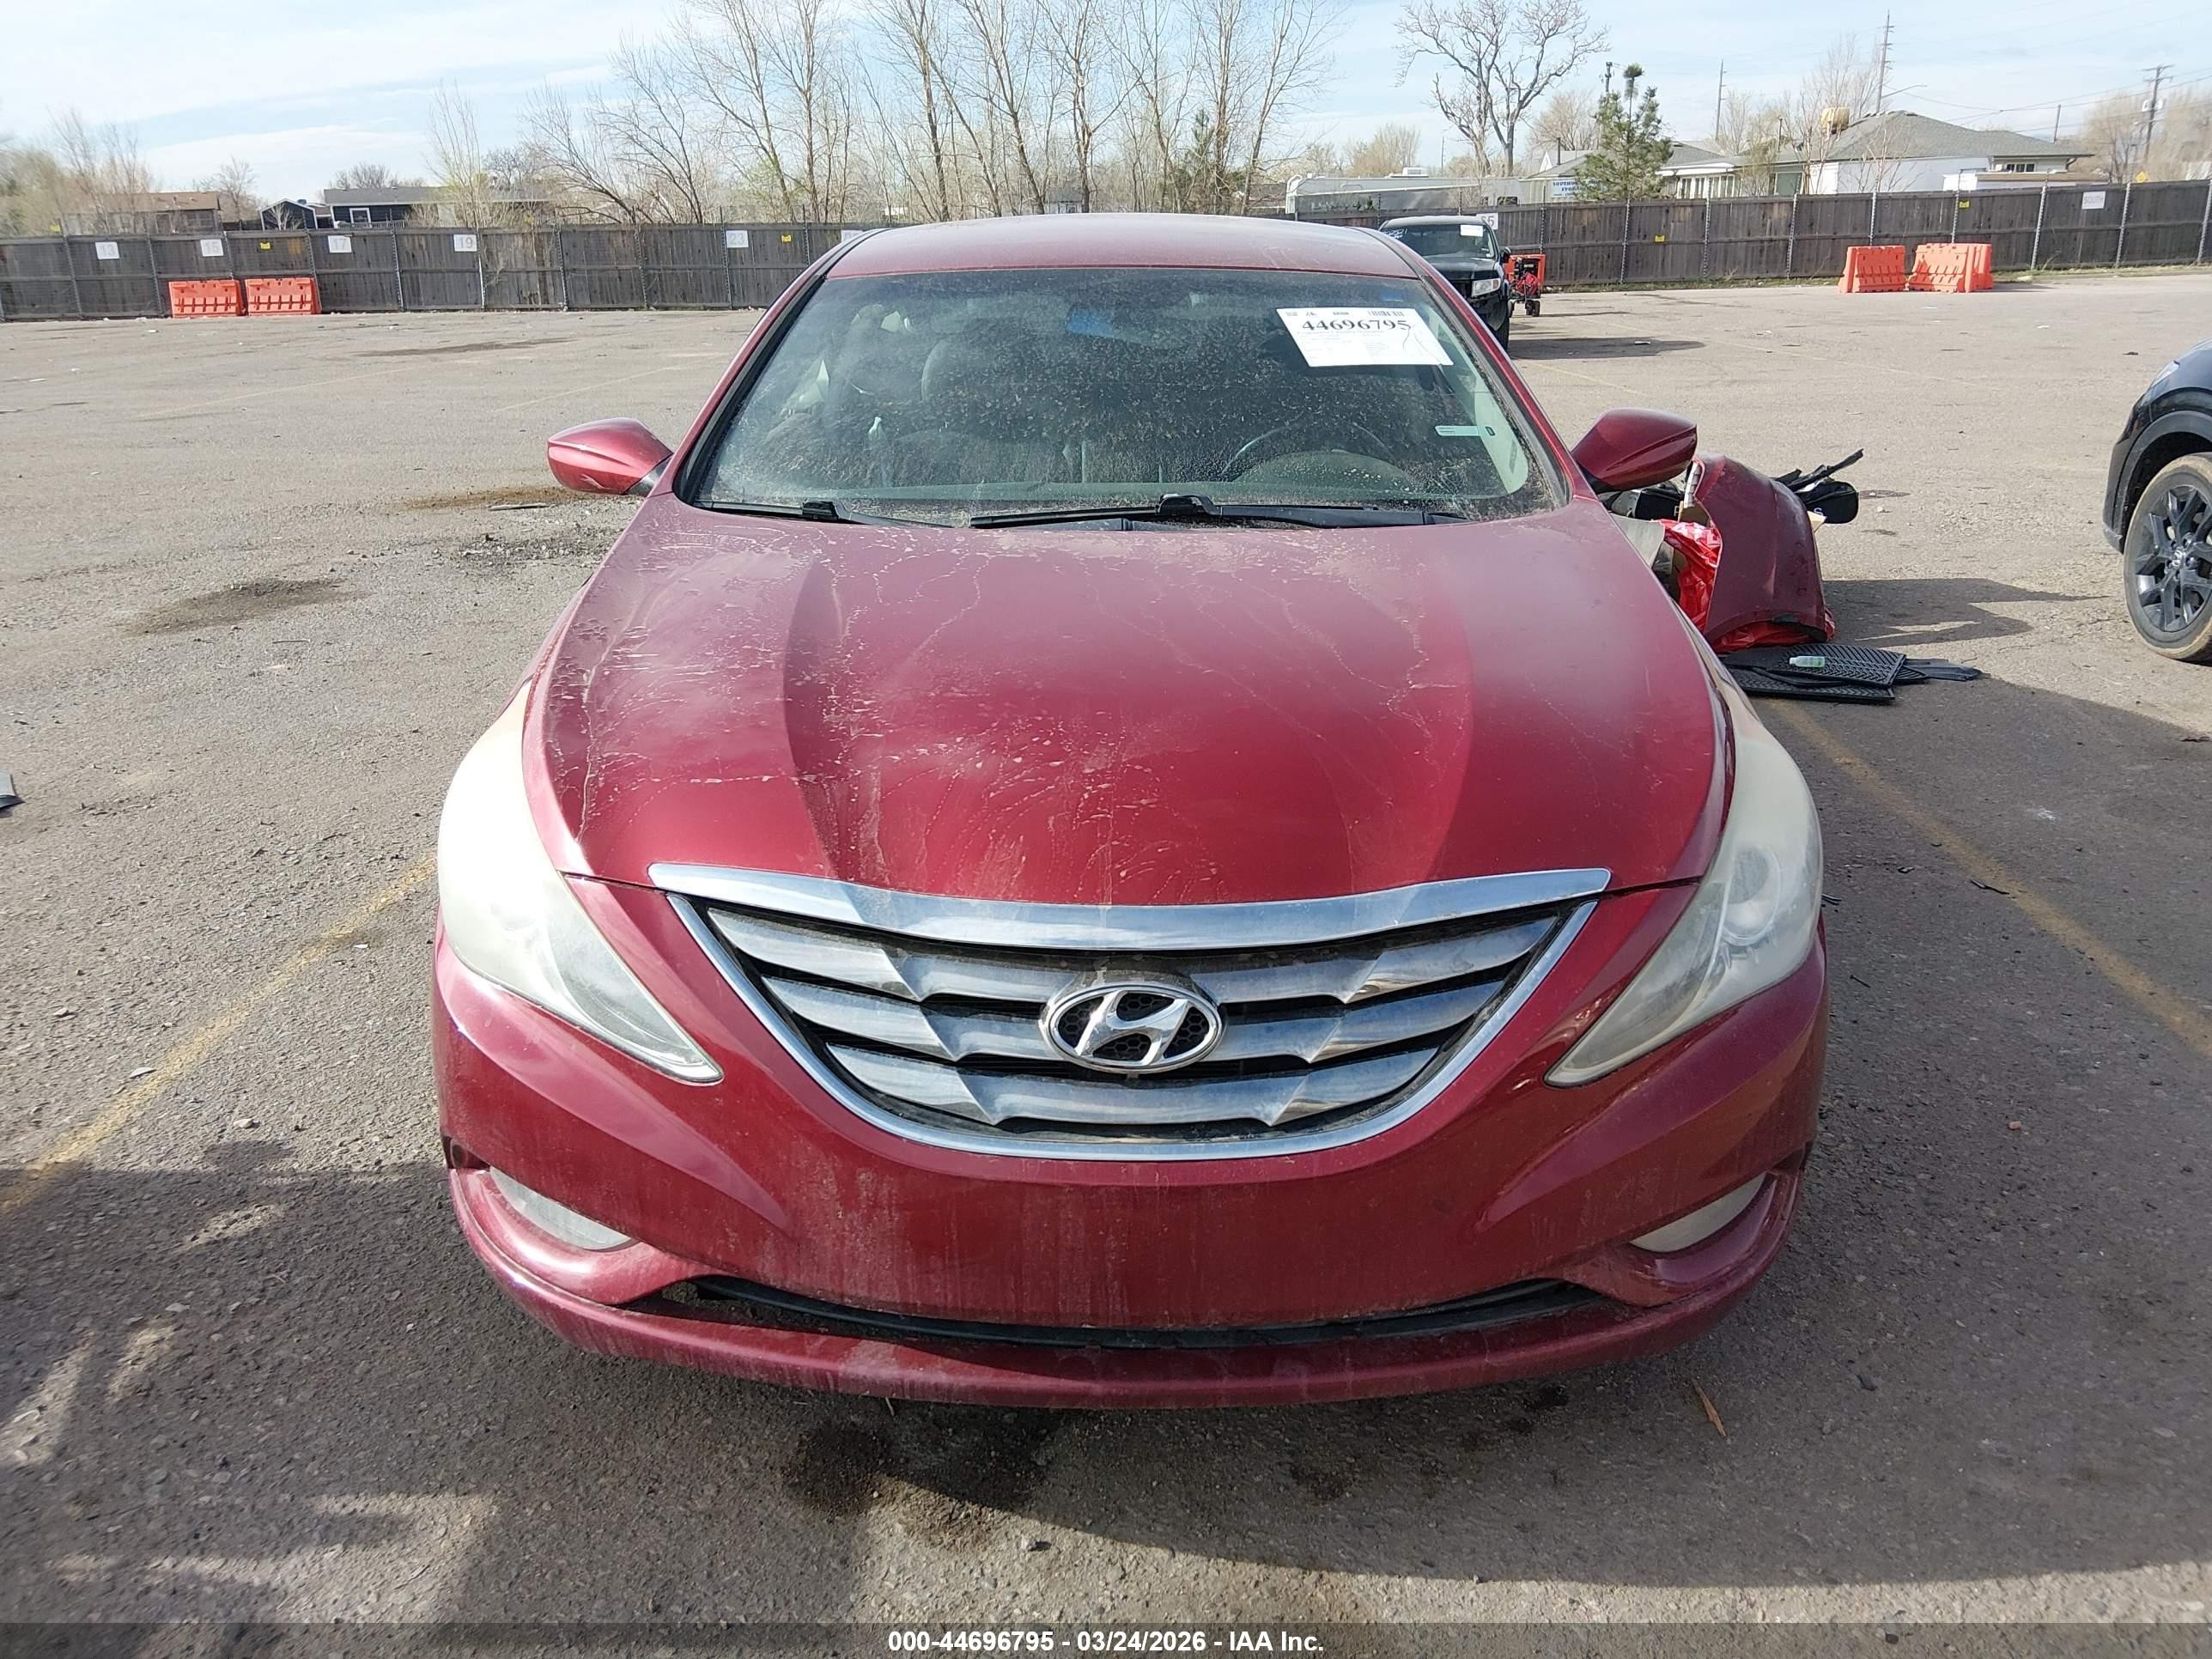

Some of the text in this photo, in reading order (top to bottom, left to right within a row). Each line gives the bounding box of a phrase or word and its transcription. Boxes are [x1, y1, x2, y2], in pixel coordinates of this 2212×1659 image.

[332, 237, 346, 250] 17
[459, 236, 474, 249] 19
[100, 243, 115, 256] 13
[1302, 319, 1411, 331] 44696795
